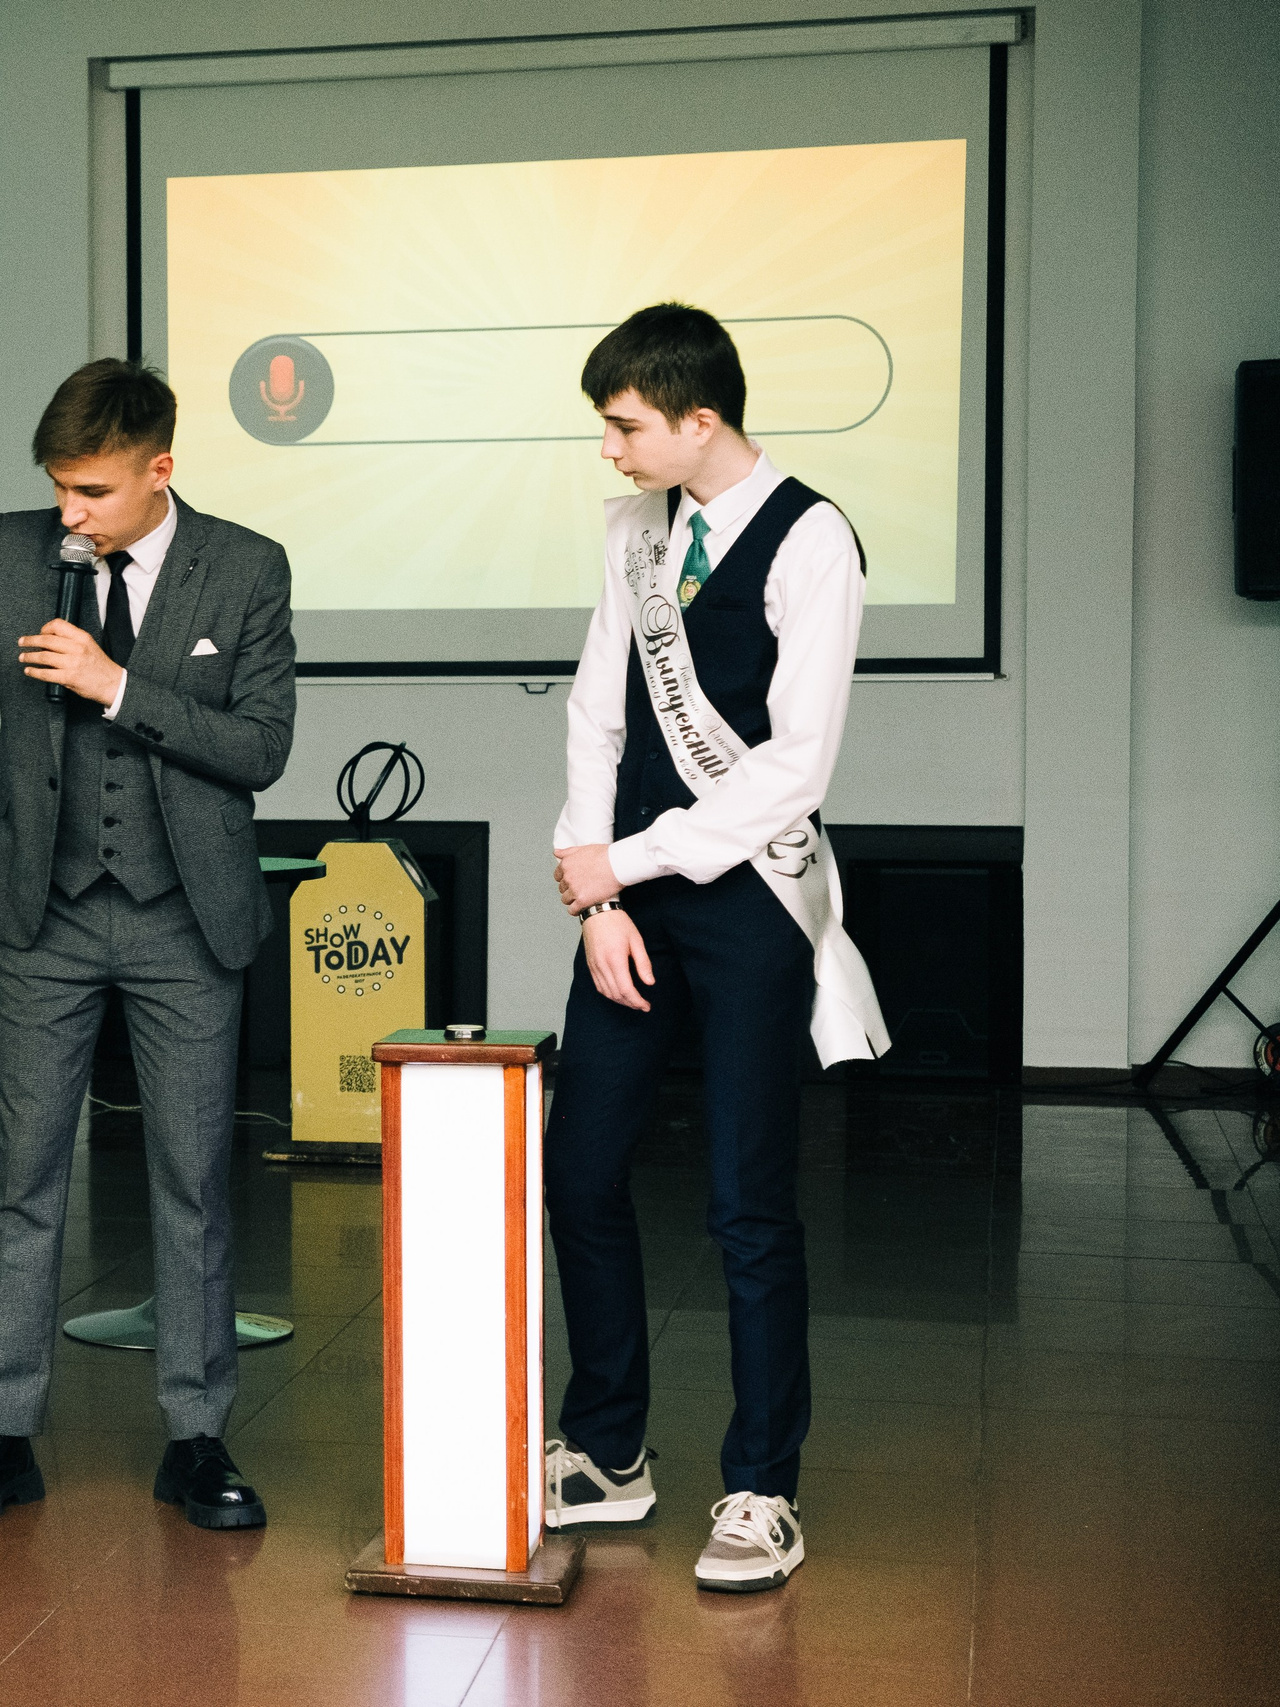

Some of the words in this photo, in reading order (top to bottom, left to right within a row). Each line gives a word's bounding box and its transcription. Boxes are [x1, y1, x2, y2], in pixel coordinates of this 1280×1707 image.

[701, 714, 740, 767] Александ
[304, 922, 361, 948] SHOW
[306, 935, 411, 974] TODAY
